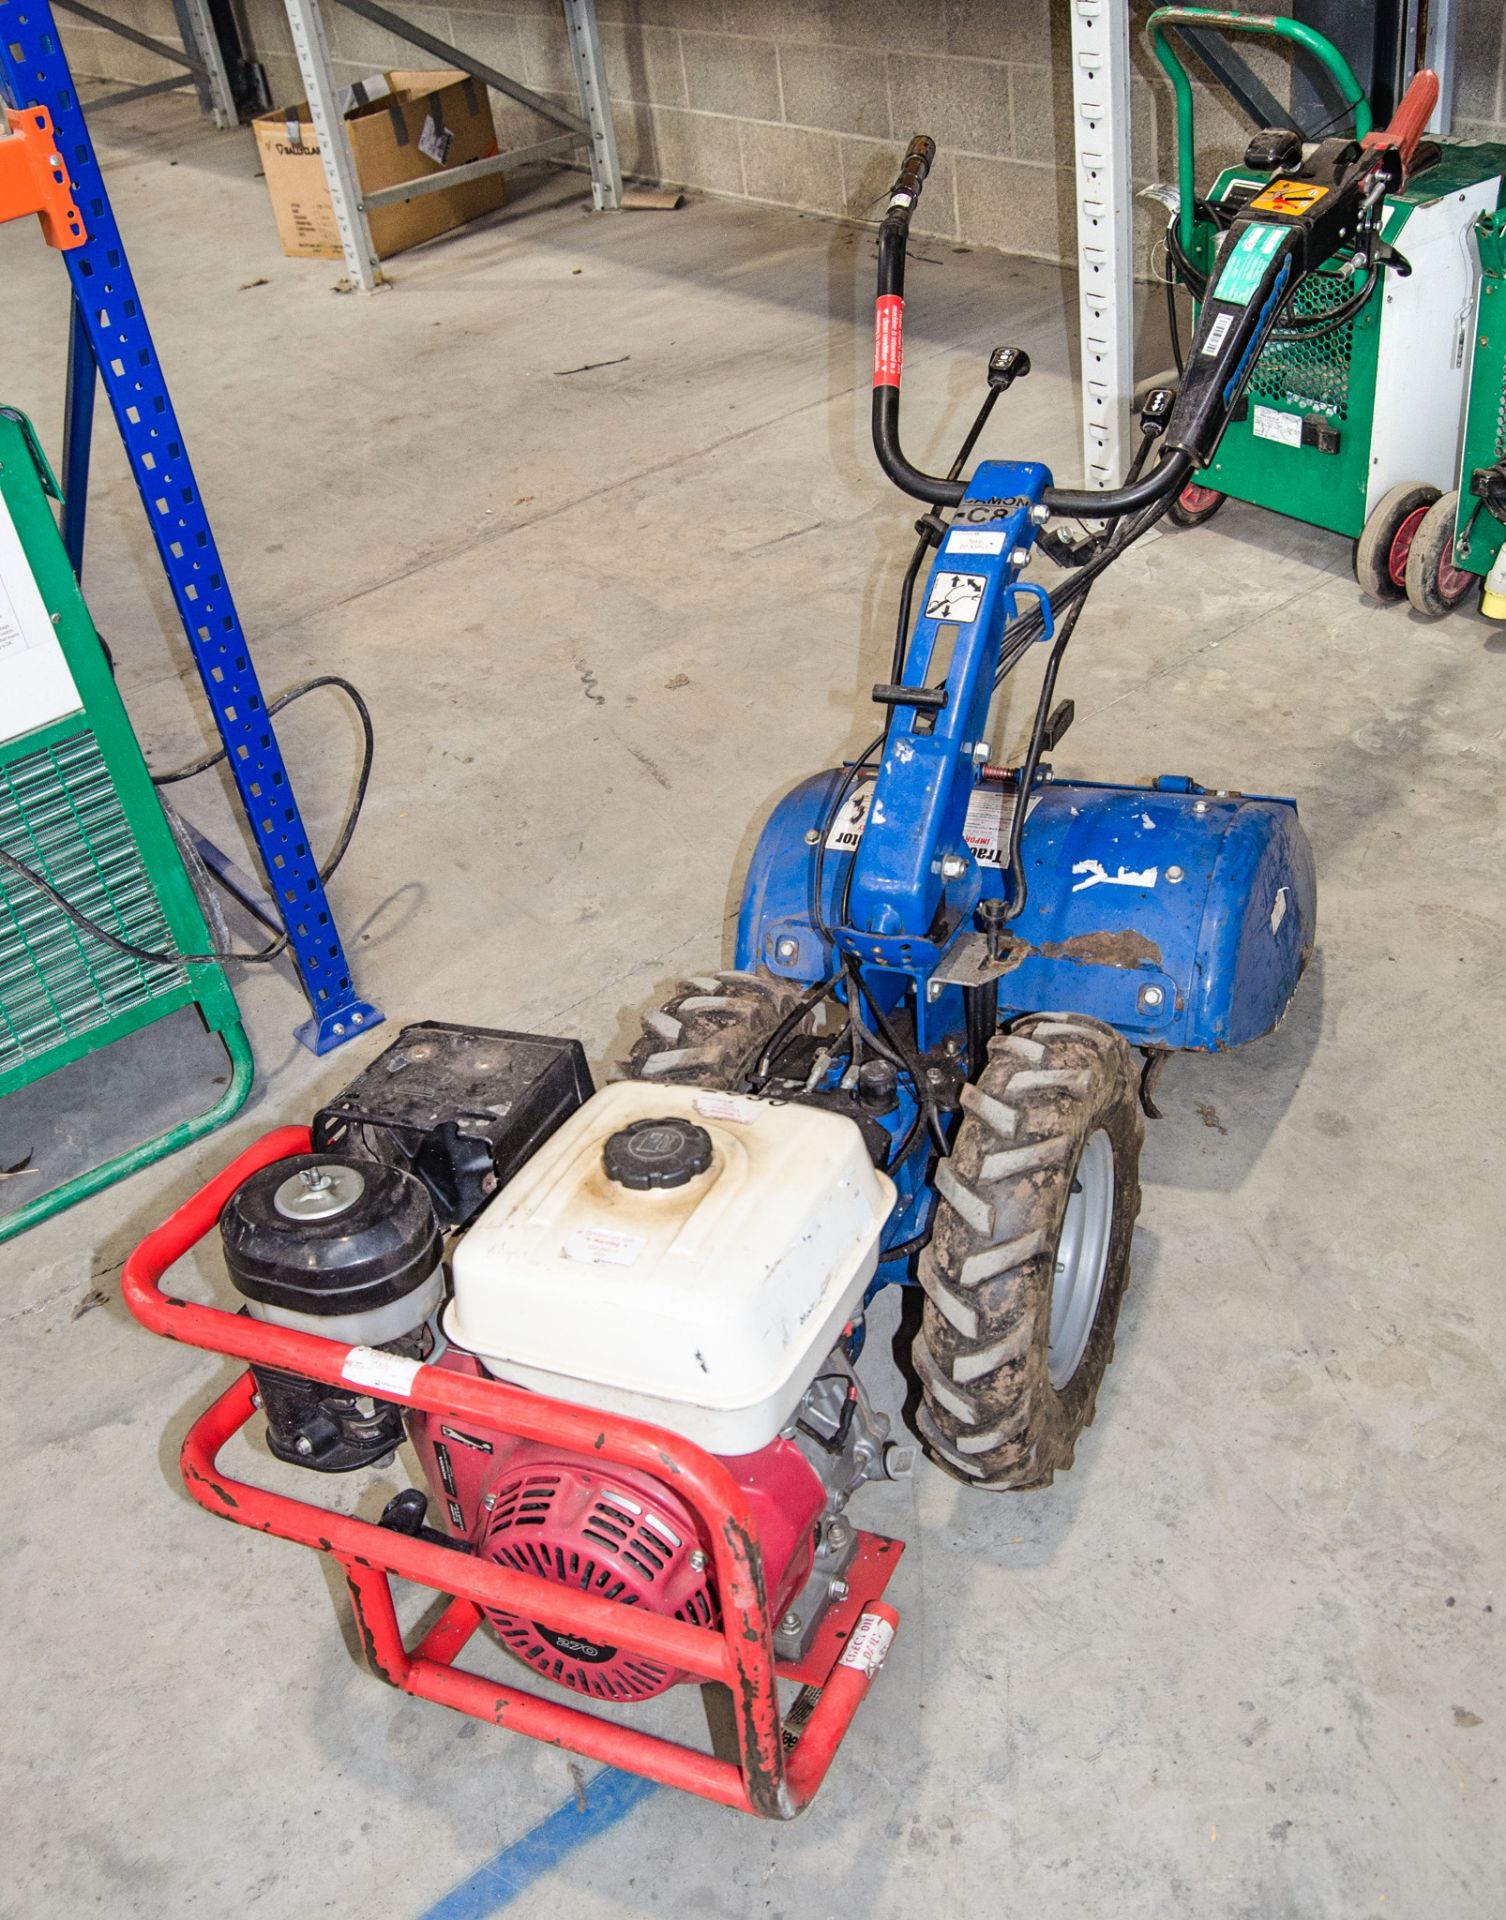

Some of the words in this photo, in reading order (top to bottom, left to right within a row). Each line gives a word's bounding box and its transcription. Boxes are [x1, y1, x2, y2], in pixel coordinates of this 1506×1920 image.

[965, 496, 1028, 507] AMON
[860, 1618, 875, 1631] OIL
[556, 1636, 599, 1657] 270
